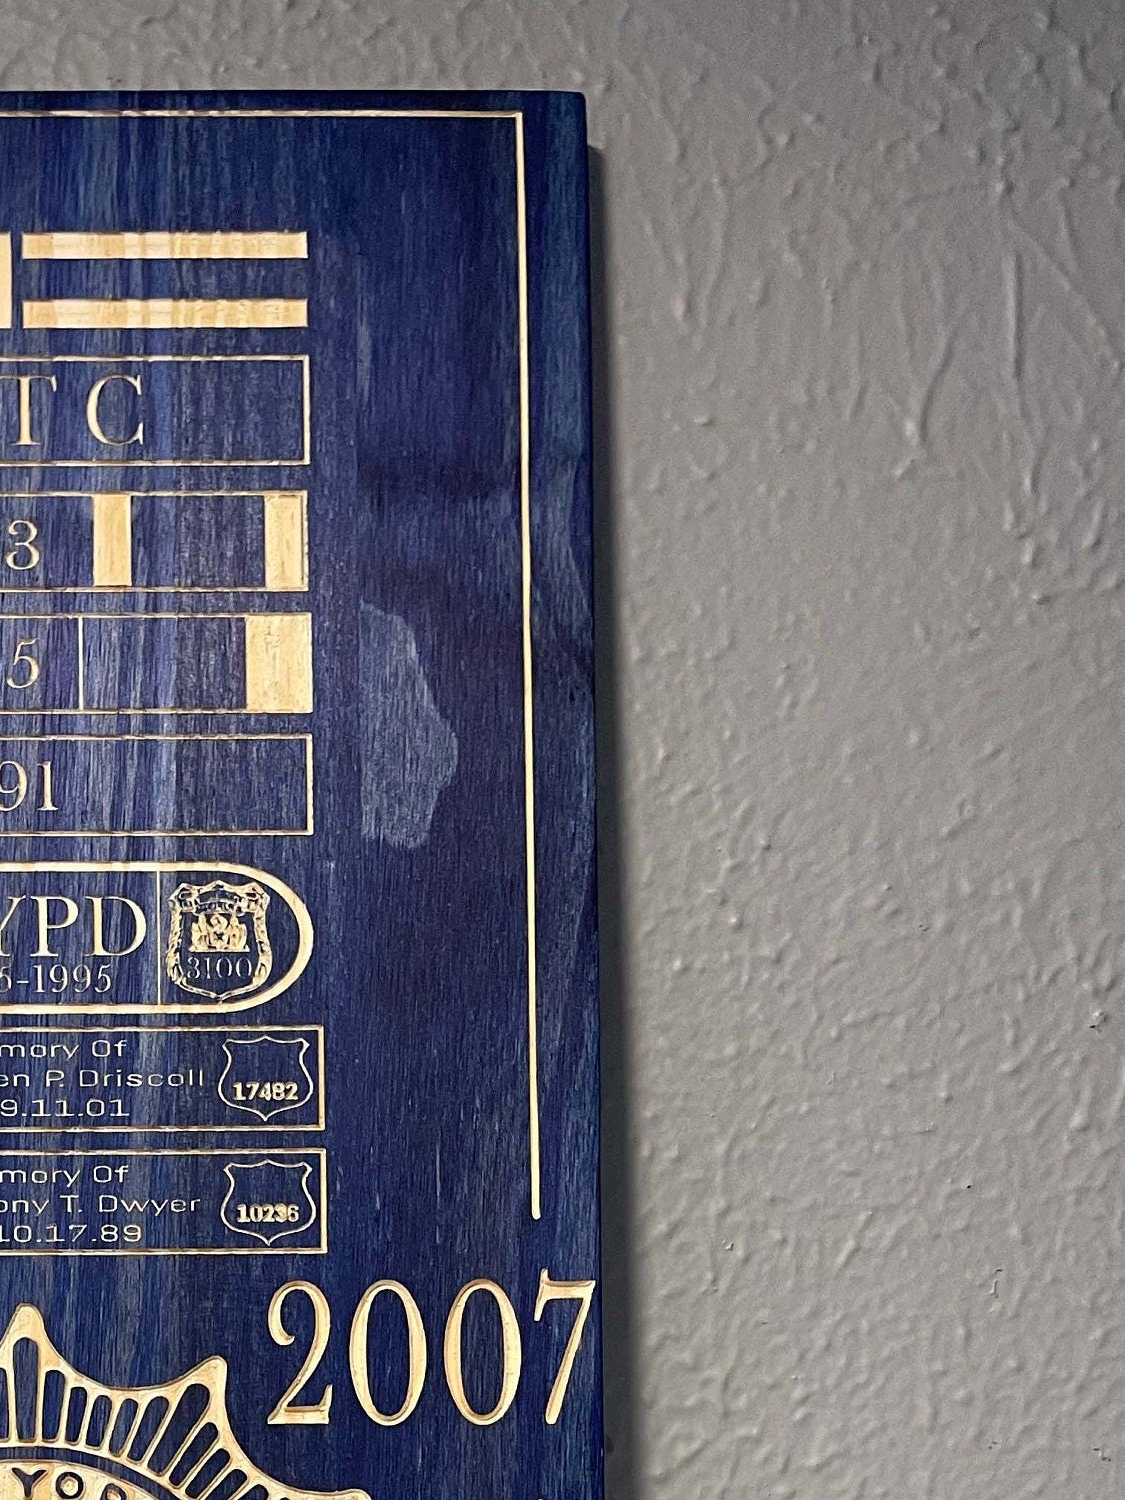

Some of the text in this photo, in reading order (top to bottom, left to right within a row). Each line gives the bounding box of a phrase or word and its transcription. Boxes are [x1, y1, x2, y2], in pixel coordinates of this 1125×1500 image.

[5, 519, 40, 570] 3
[6, 638, 40, 689] 5
[187, 956, 252, 980] 3100
[91, 1040, 127, 1058] Of
[45, 1070, 65, 1087] P.
[79, 1069, 204, 1087] Driscoll
[233, 1081, 299, 1101] 17482
[0, 1099, 130, 1118] 9.11.01
[93, 1165, 129, 1183] Of
[59, 1195, 82, 1213] T.
[98, 1195, 201, 1216] Dwyer
[266, 1269, 595, 1428] 2007
